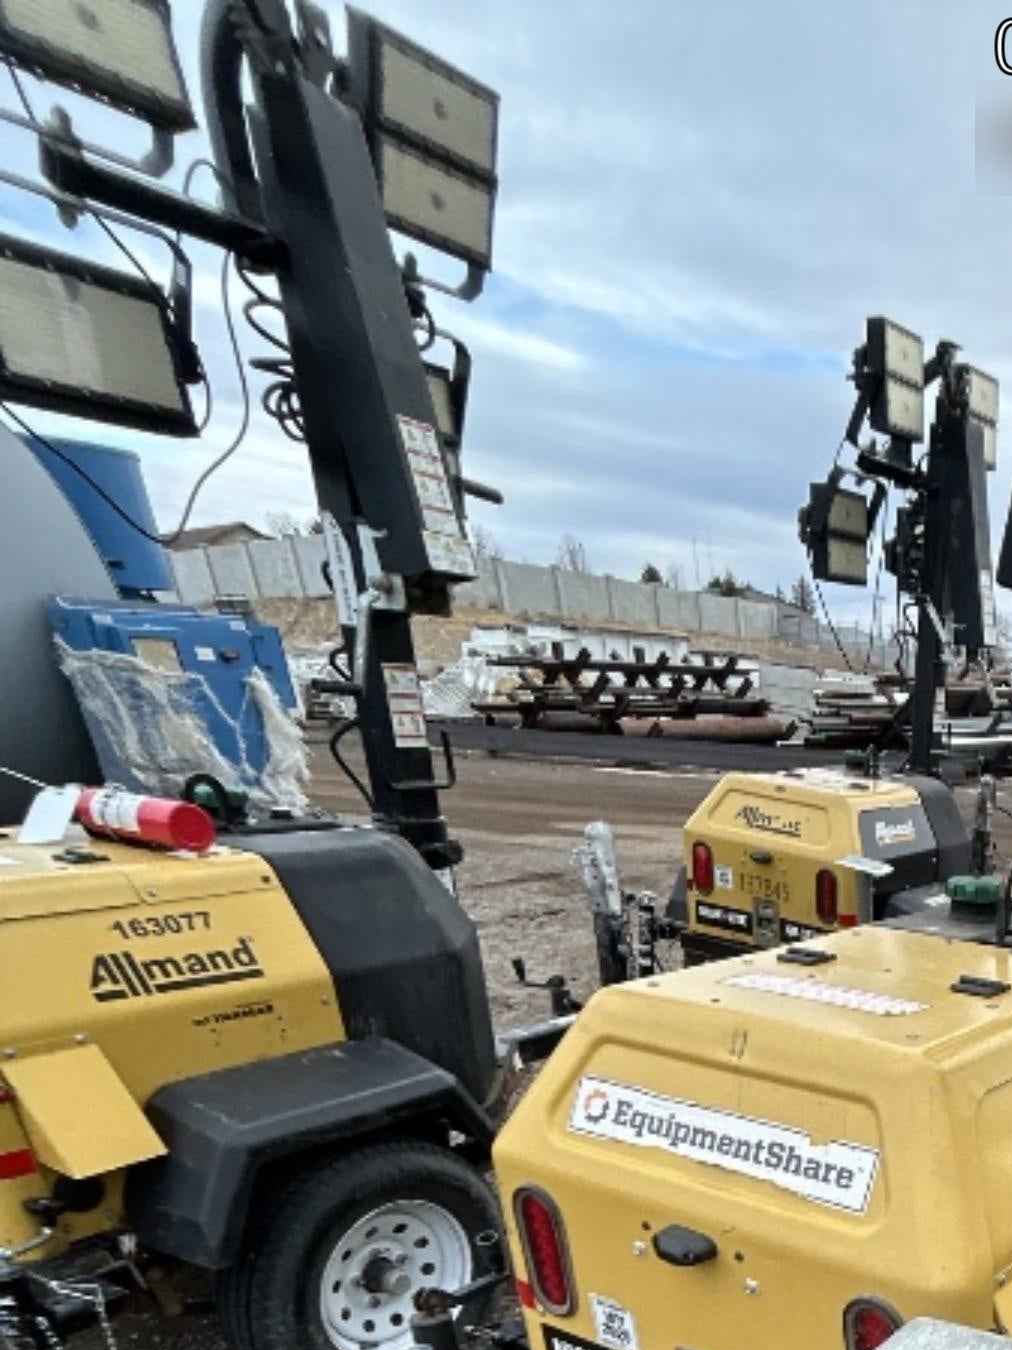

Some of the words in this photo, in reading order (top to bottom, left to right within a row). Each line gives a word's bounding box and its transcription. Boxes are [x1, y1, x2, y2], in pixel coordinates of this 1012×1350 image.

[109, 911, 211, 940] 163077
[90, 936, 262, 1001] Allmand
[611, 1100, 855, 1190] EquipmentShare
